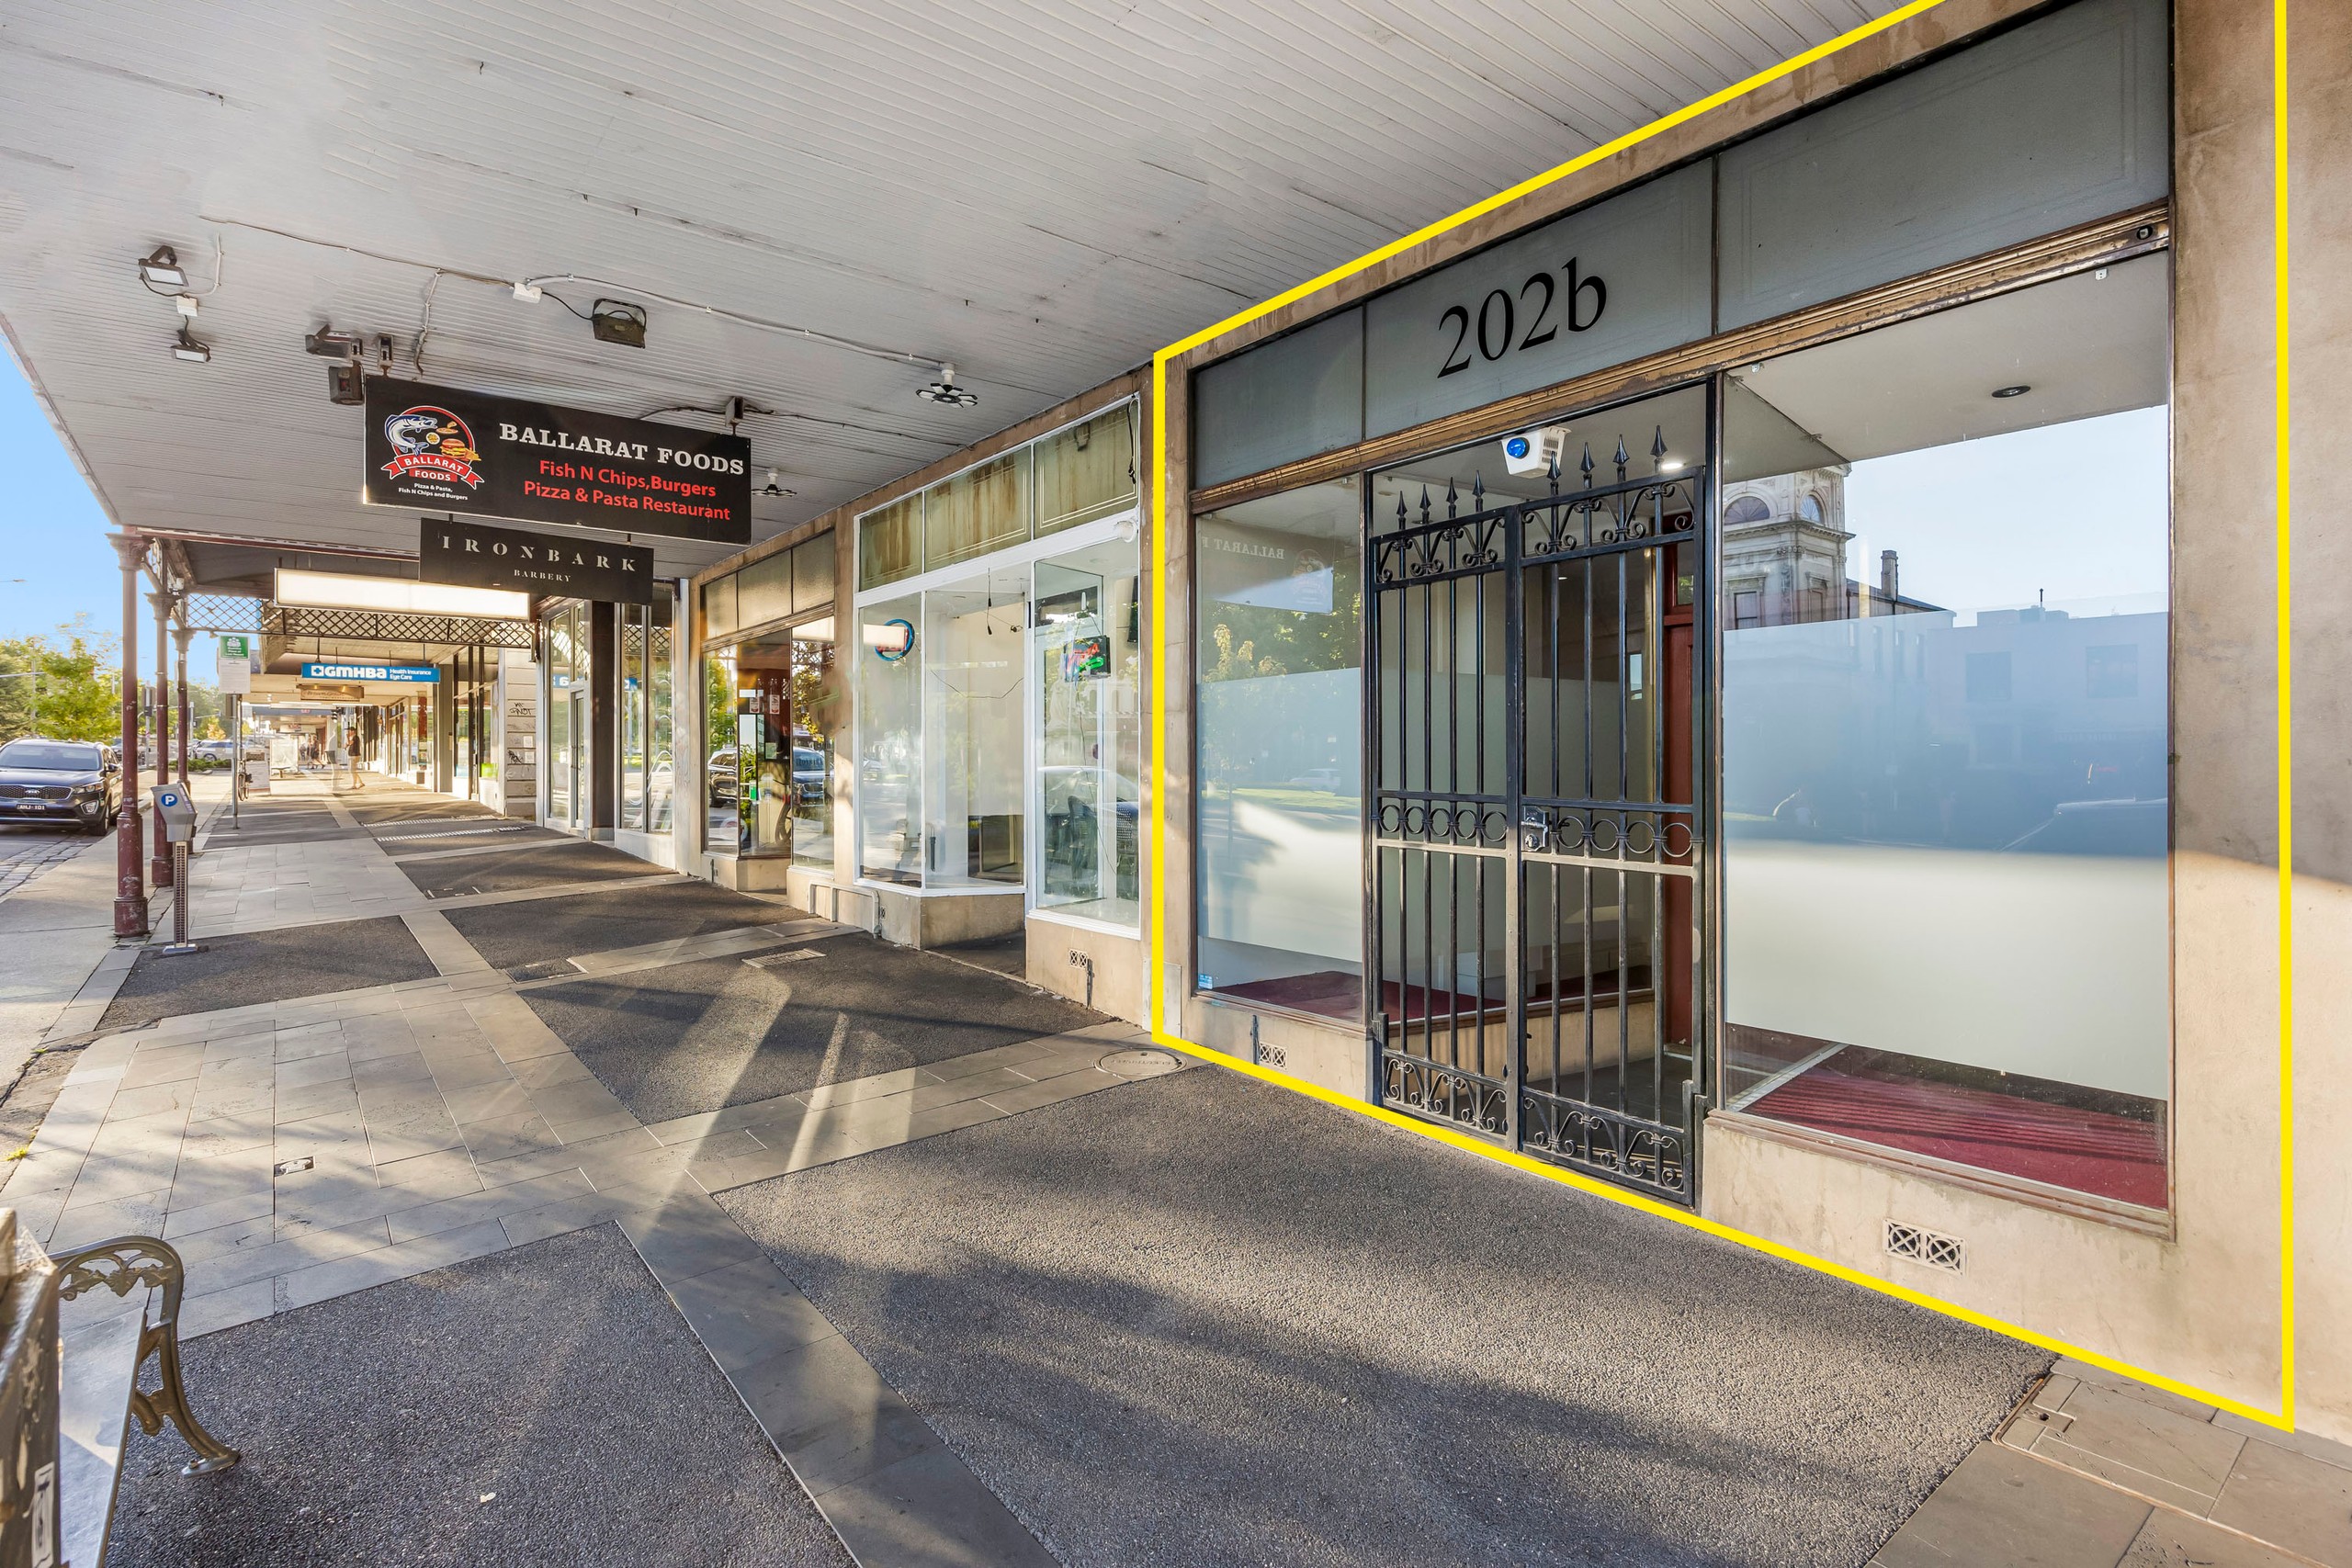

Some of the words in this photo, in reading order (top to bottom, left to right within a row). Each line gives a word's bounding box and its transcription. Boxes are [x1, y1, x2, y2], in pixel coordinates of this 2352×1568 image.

[1437, 256, 1607, 378] 202b
[499, 423, 648, 460] BALLARAT
[657, 447, 744, 476] FOODS
[404, 457, 463, 473] BALLARAT
[414, 469, 451, 481] FOODS
[539, 460, 575, 479] Fish
[581, 466, 594, 480] N
[524, 480, 571, 501] Pizza
[575, 487, 589, 502] &
[593, 490, 639, 509] Pasta
[643, 496, 730, 521] Restaurant
[442, 536, 636, 572] IRONBARK
[514, 569, 571, 582] BARBERY
[165, 795, 175, 805] P
